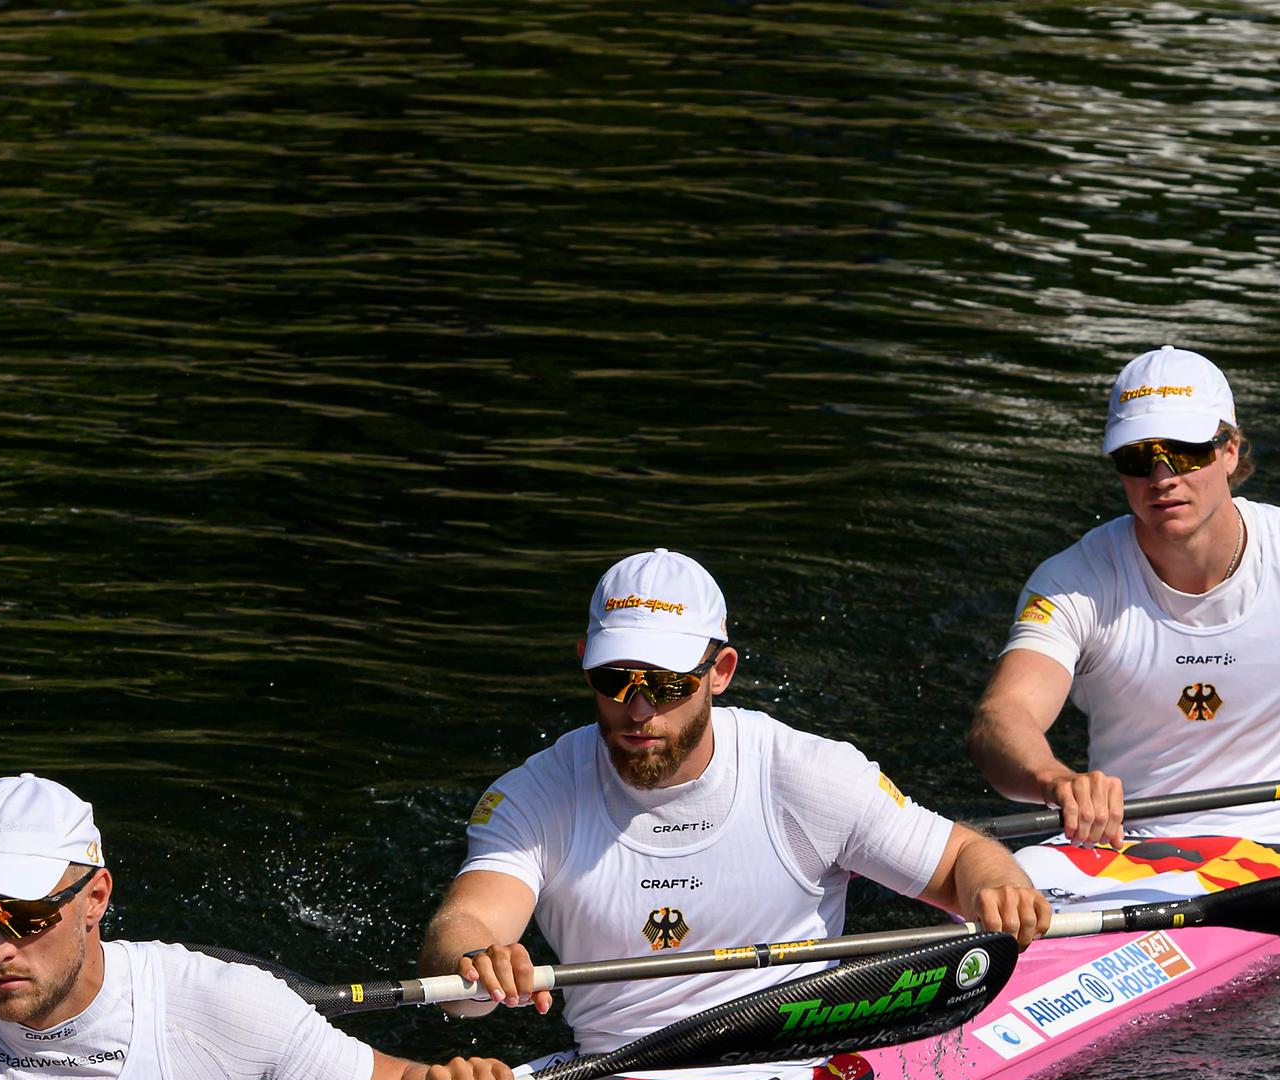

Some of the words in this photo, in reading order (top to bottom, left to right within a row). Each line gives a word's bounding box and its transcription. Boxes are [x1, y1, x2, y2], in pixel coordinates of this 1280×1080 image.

[1175, 655, 1223, 665] CRAFT
[652, 823, 699, 833] CRAFT
[640, 879, 689, 889] CRAFT
[1091, 943, 1150, 981] BRAIN
[1138, 933, 1170, 959] 247
[1111, 962, 1169, 1000] HOUSE
[1023, 987, 1092, 1027] Allianz
[25, 1031, 63, 1041] CRAFT
